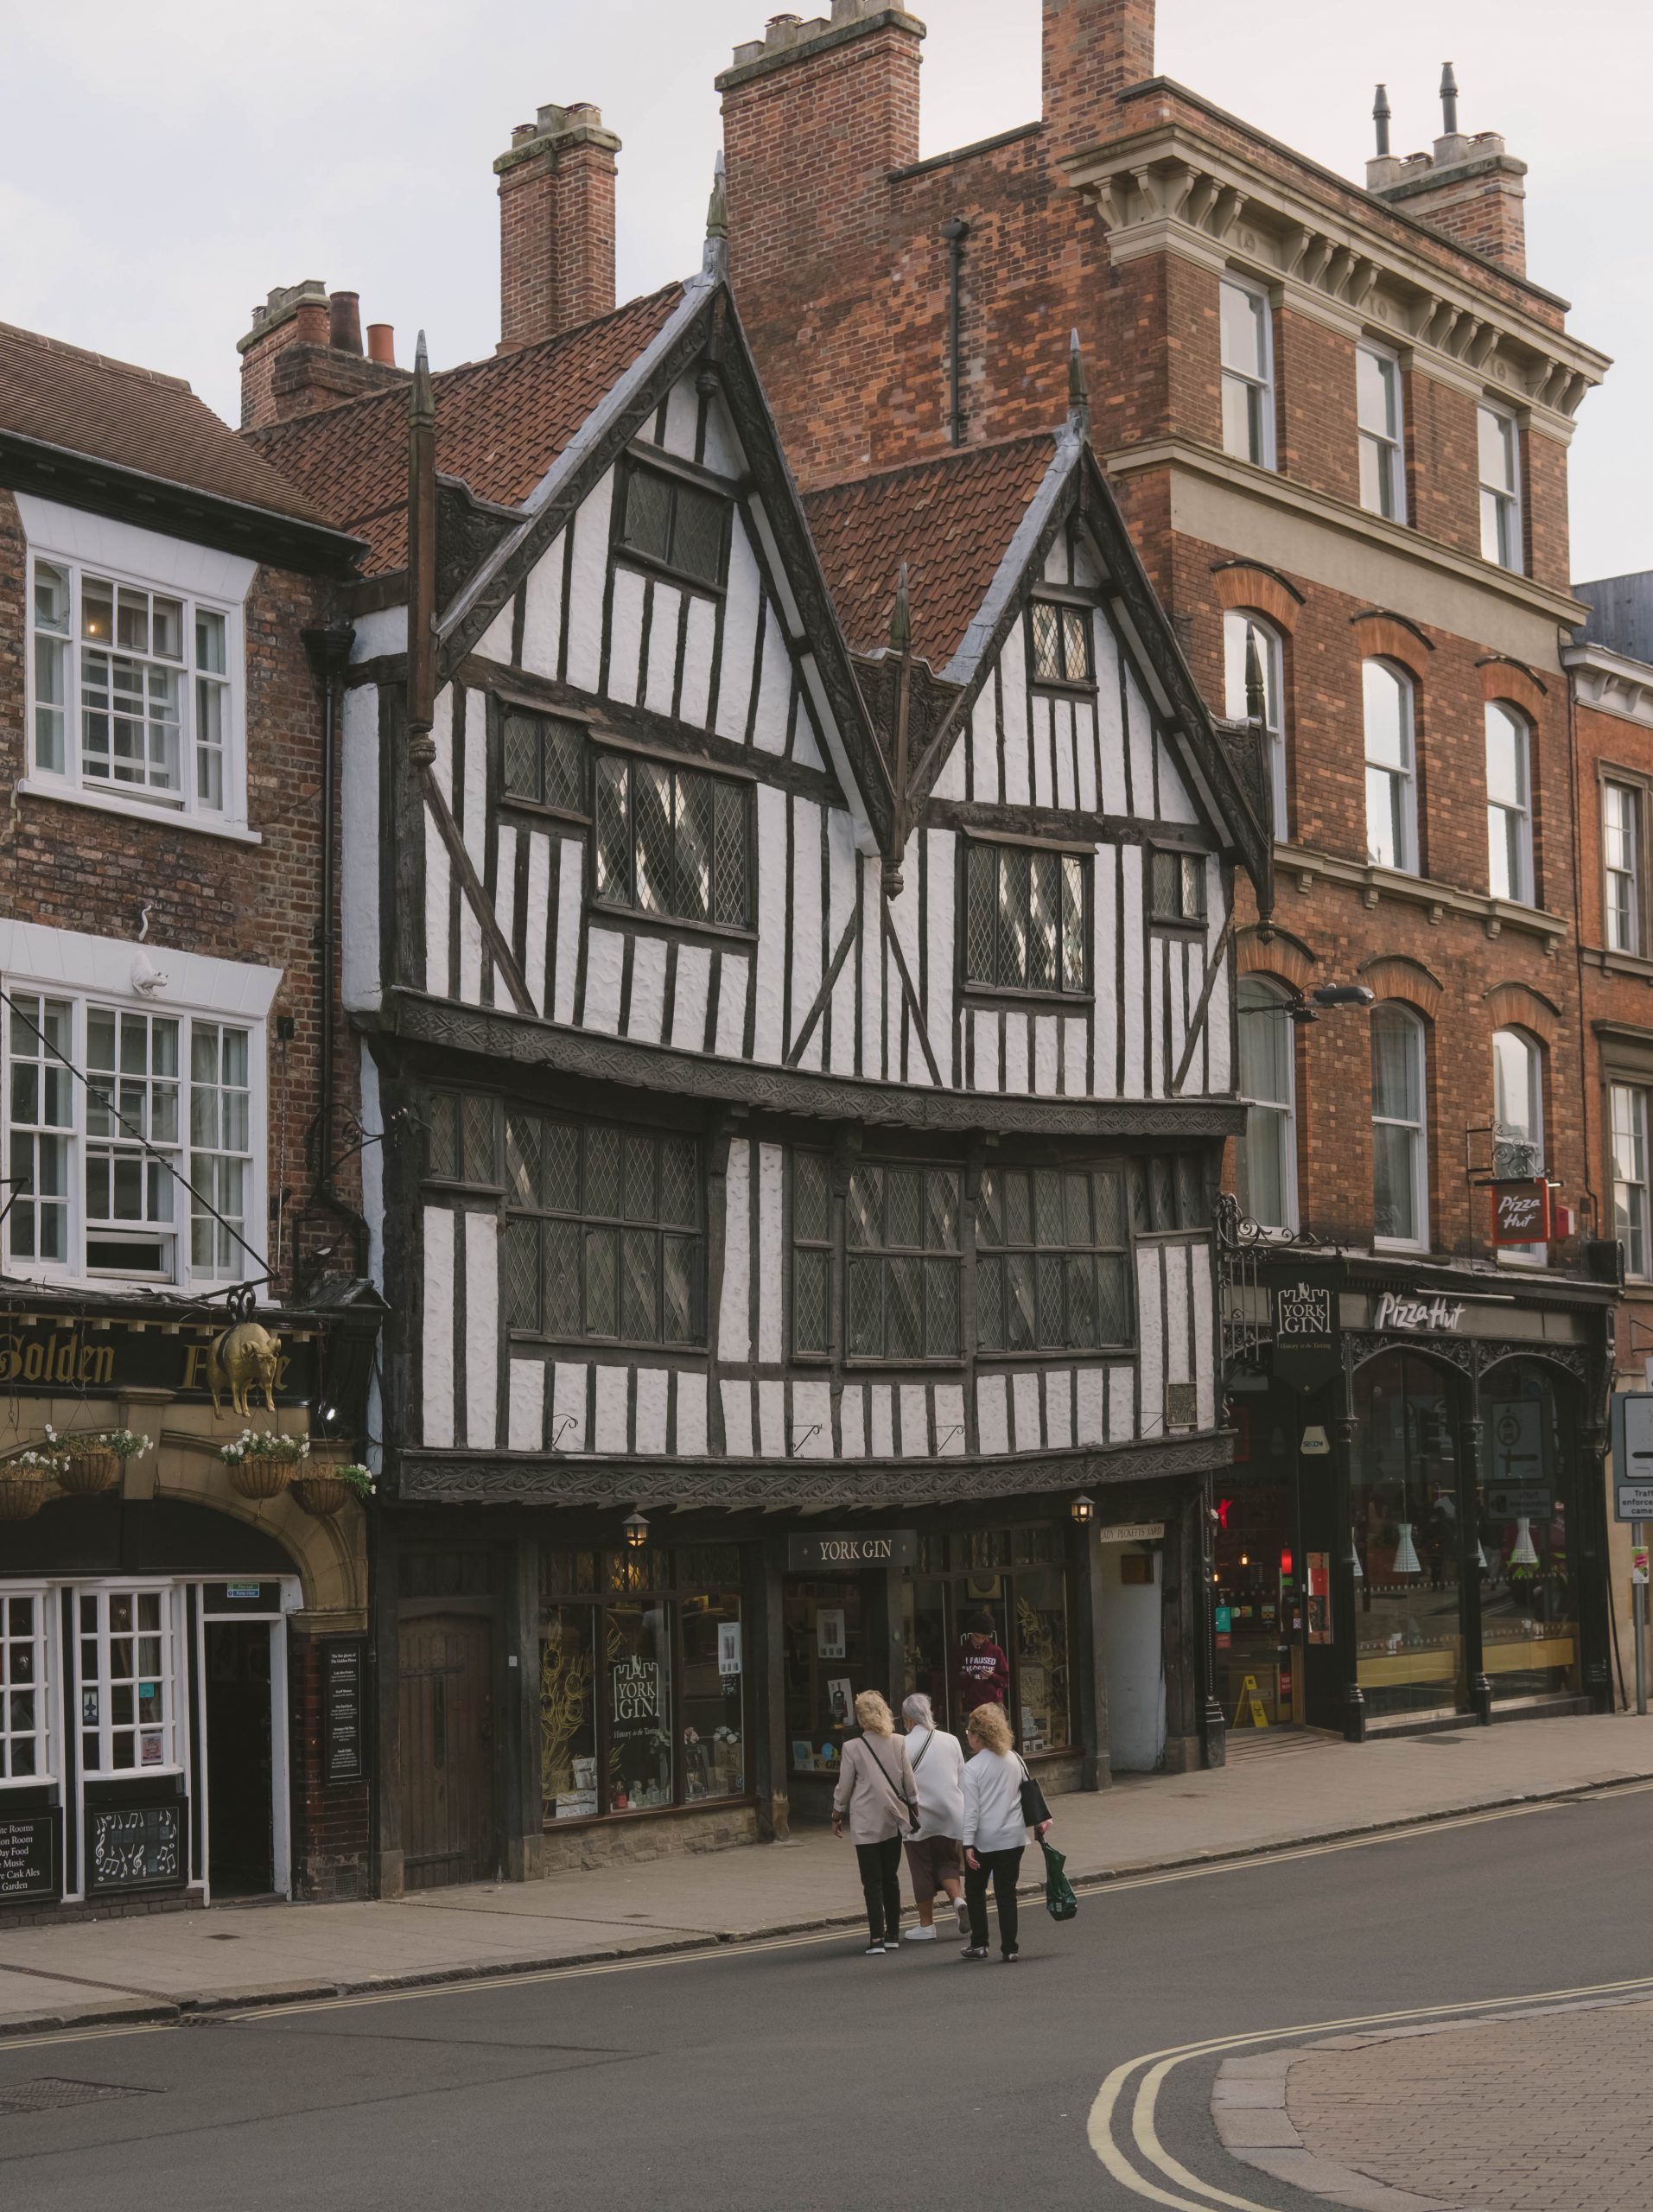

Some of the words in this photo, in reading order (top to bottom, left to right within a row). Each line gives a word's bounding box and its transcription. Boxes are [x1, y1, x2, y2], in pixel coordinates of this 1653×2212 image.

[1497, 1196, 1541, 1214] Pizza
[1504, 1213, 1536, 1229] Hut
[1283, 1304, 1326, 1318] YORK
[1375, 1291, 1428, 1329] Pizza
[1428, 1297, 1465, 1330] Hut
[1284, 1316, 1325, 1333] GIN
[0, 1333, 115, 1382] Golden
[1147, 1526, 1161, 1535] YARD
[819, 1541, 861, 1560] YORK
[862, 1539, 893, 1558] GIN
[618, 1681, 656, 1699] YORK
[620, 1696, 655, 1719] GIN
[9, 1825, 34, 1834] Rooms
[11, 1835, 33, 1845] Room
[11, 1846, 29, 1856] Food
[3, 1858, 25, 1868] Music
[6, 1870, 24, 1879] Cask
[25, 1867, 41, 1878] Ales
[2, 1881, 28, 1891] Garden
